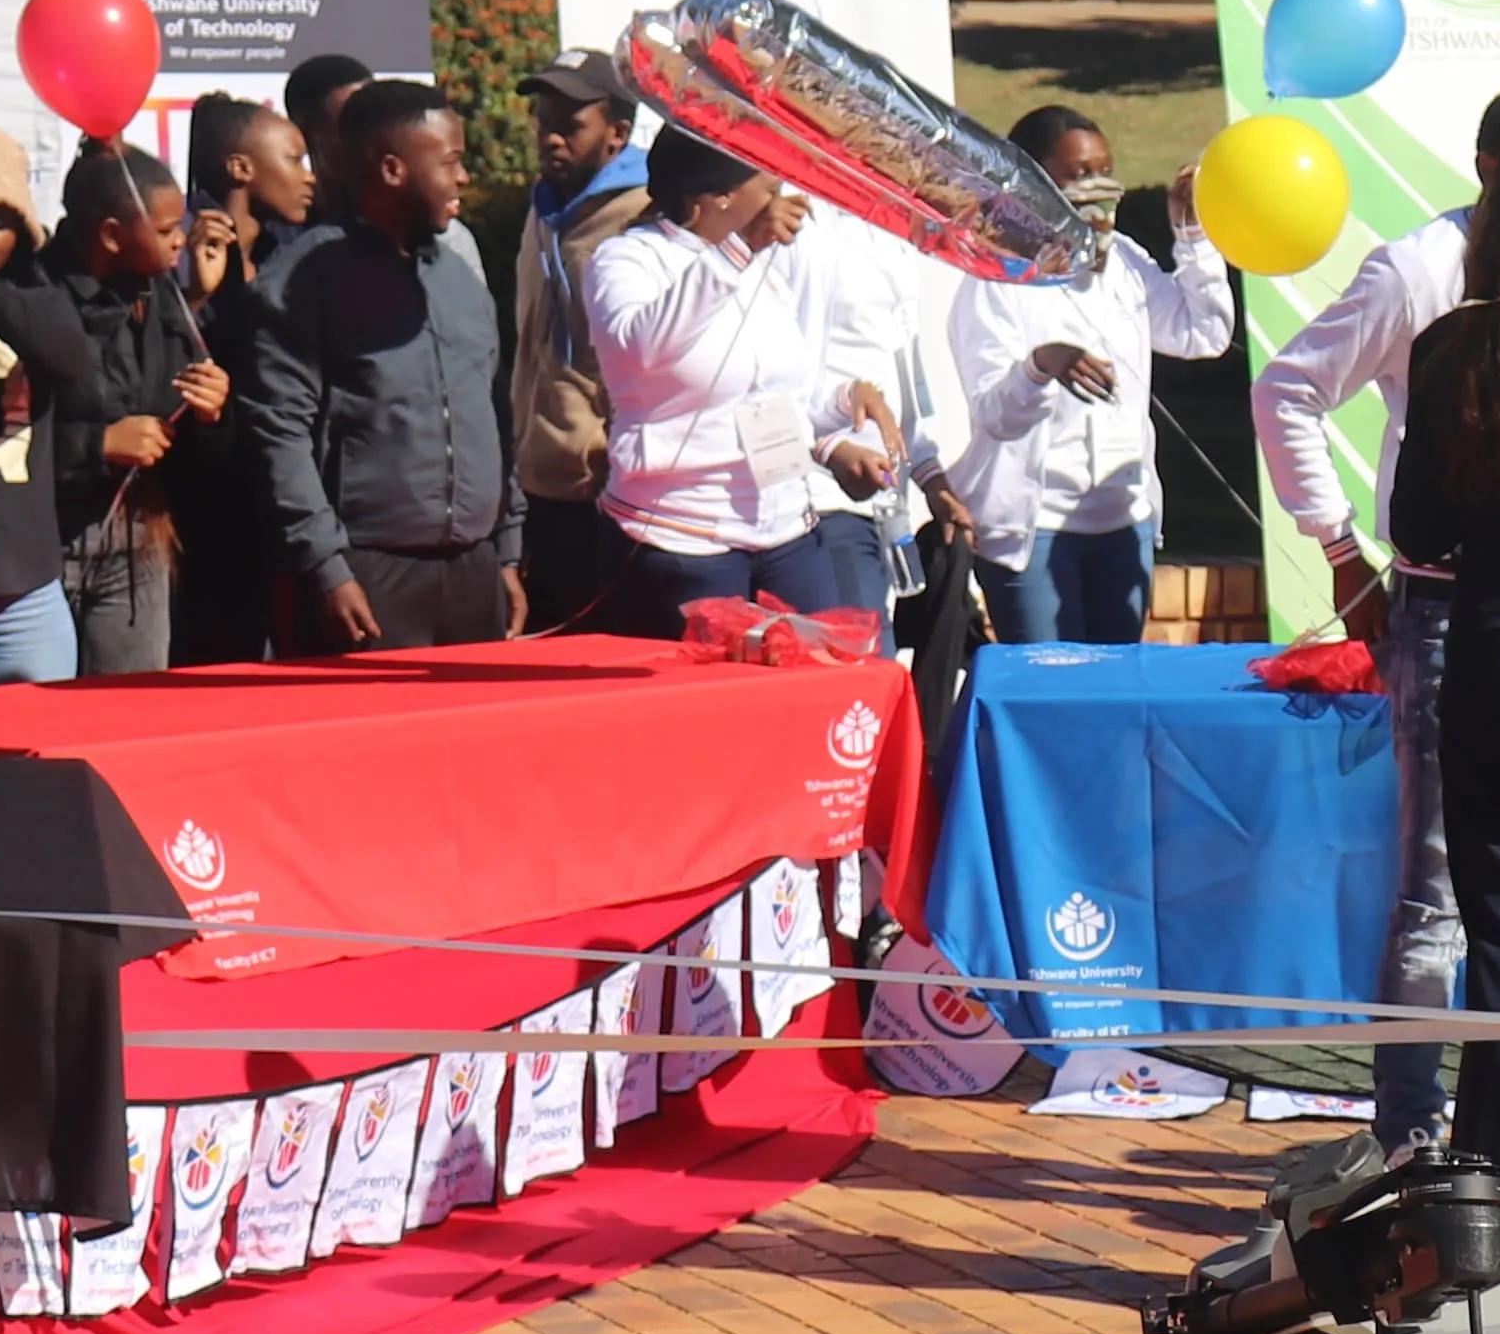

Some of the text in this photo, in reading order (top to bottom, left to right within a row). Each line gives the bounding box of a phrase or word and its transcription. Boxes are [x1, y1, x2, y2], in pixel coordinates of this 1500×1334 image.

[164, 18, 295, 42] of Technology
[191, 47, 242, 61] empower
[245, 46, 286, 61] people
[1028, 964, 1143, 981] Tshwane University
[874, 1018, 887, 1031] of
[1110, 1024, 1130, 1037] ICT
[923, 1035, 981, 1092] University
